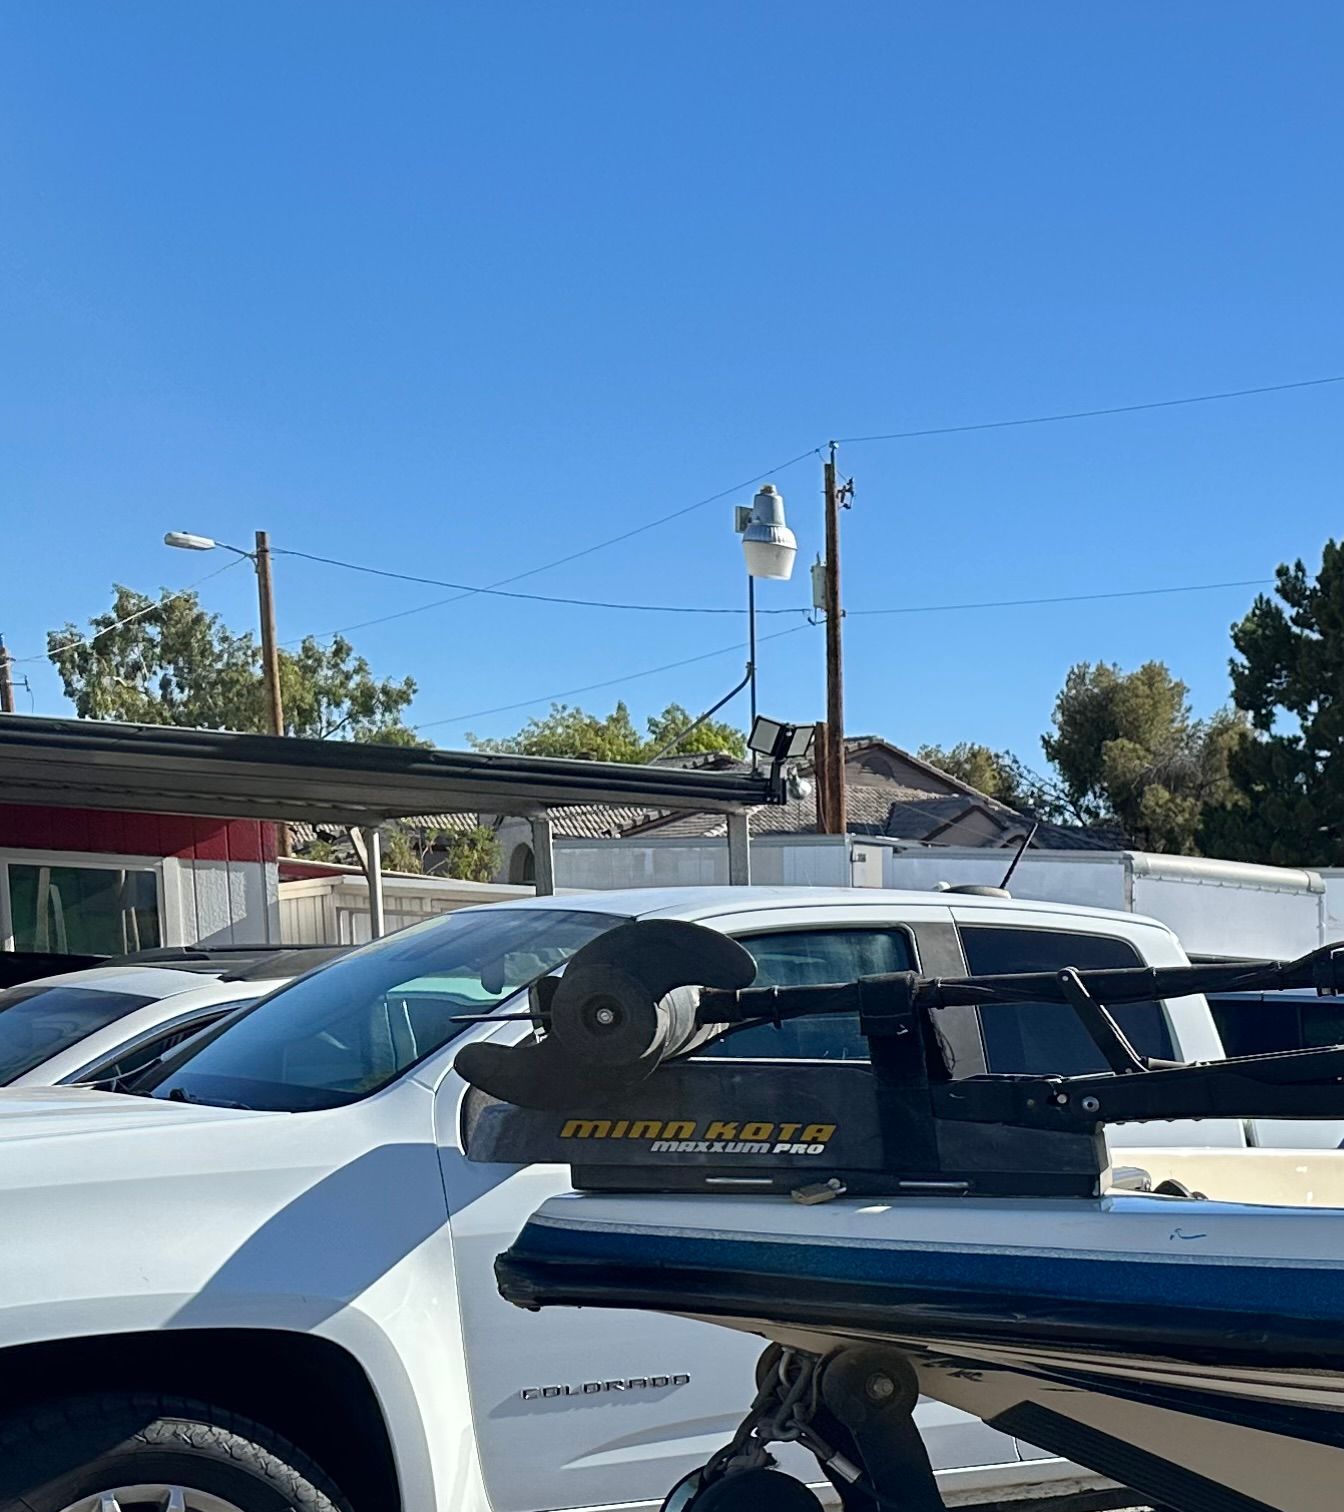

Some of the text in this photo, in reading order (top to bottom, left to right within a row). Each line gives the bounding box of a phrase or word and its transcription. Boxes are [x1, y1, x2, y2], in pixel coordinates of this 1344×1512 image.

[560, 1119, 837, 1142] MINN KOTA
[650, 1141, 825, 1155] MAXXUM PRO
[521, 1372, 692, 1400] COLORADO
